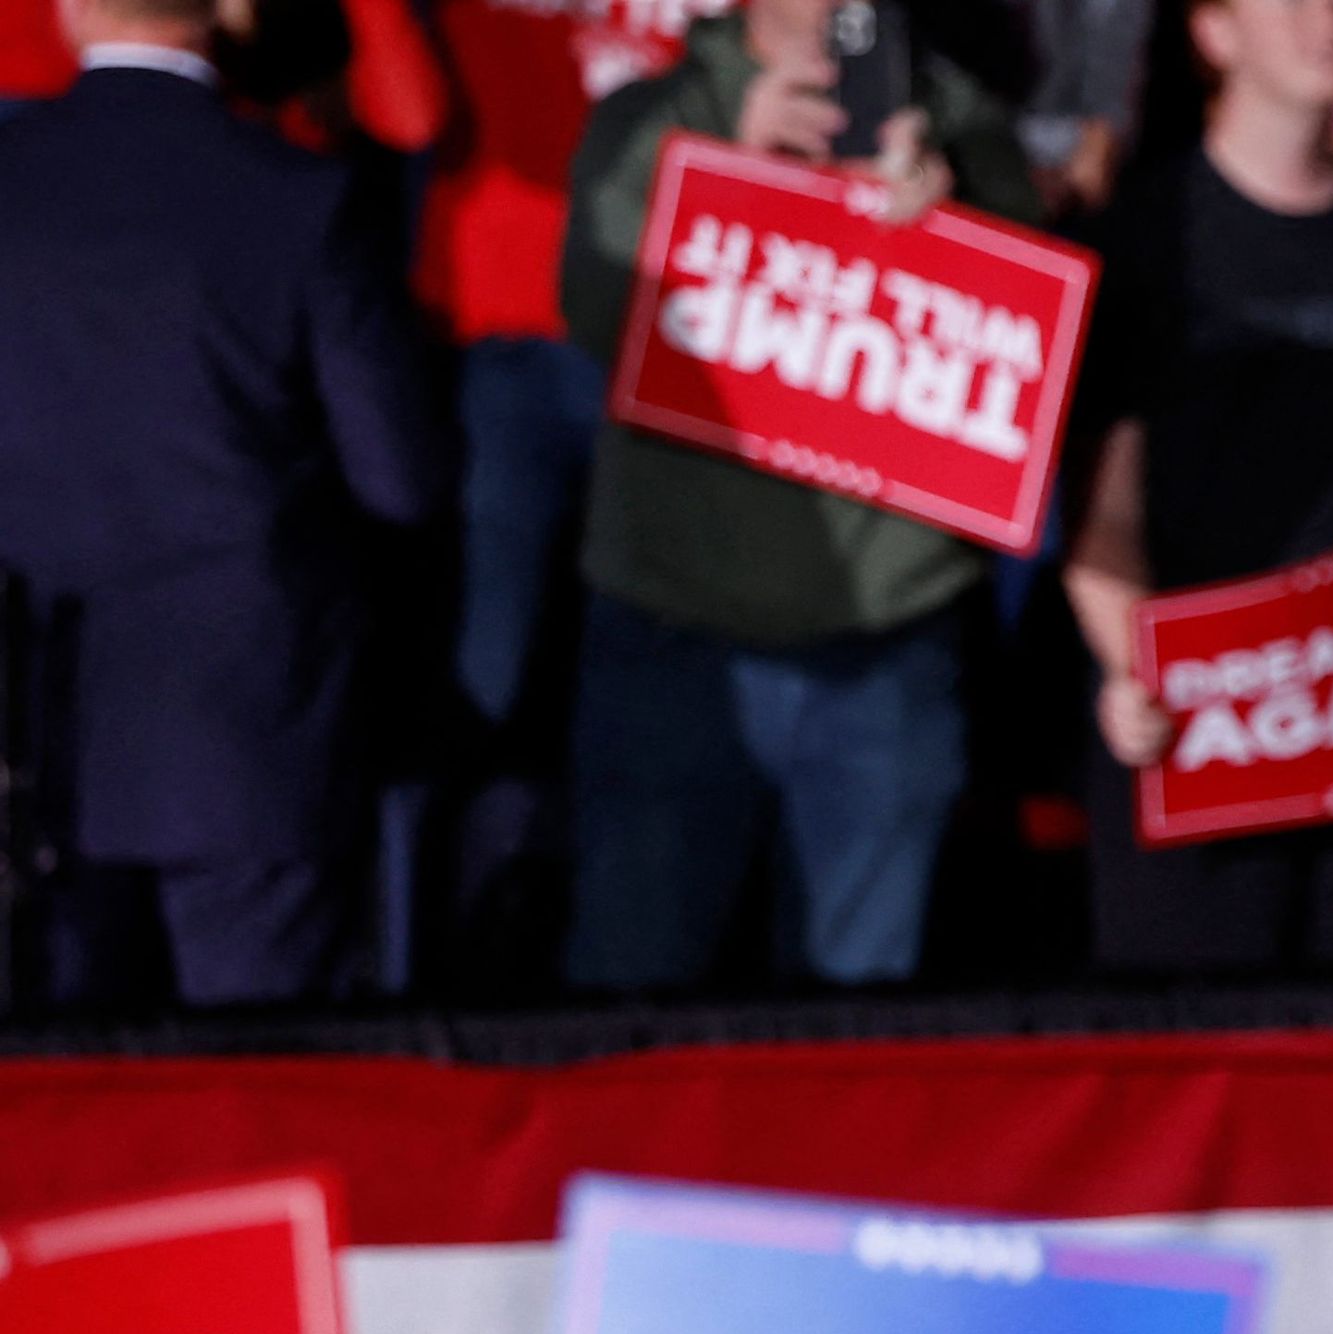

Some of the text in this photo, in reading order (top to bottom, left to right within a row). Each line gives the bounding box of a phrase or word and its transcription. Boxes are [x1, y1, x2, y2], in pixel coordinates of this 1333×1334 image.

[659, 282, 1031, 463] TRUMP
[671, 213, 1044, 382] WILL FIX IT
